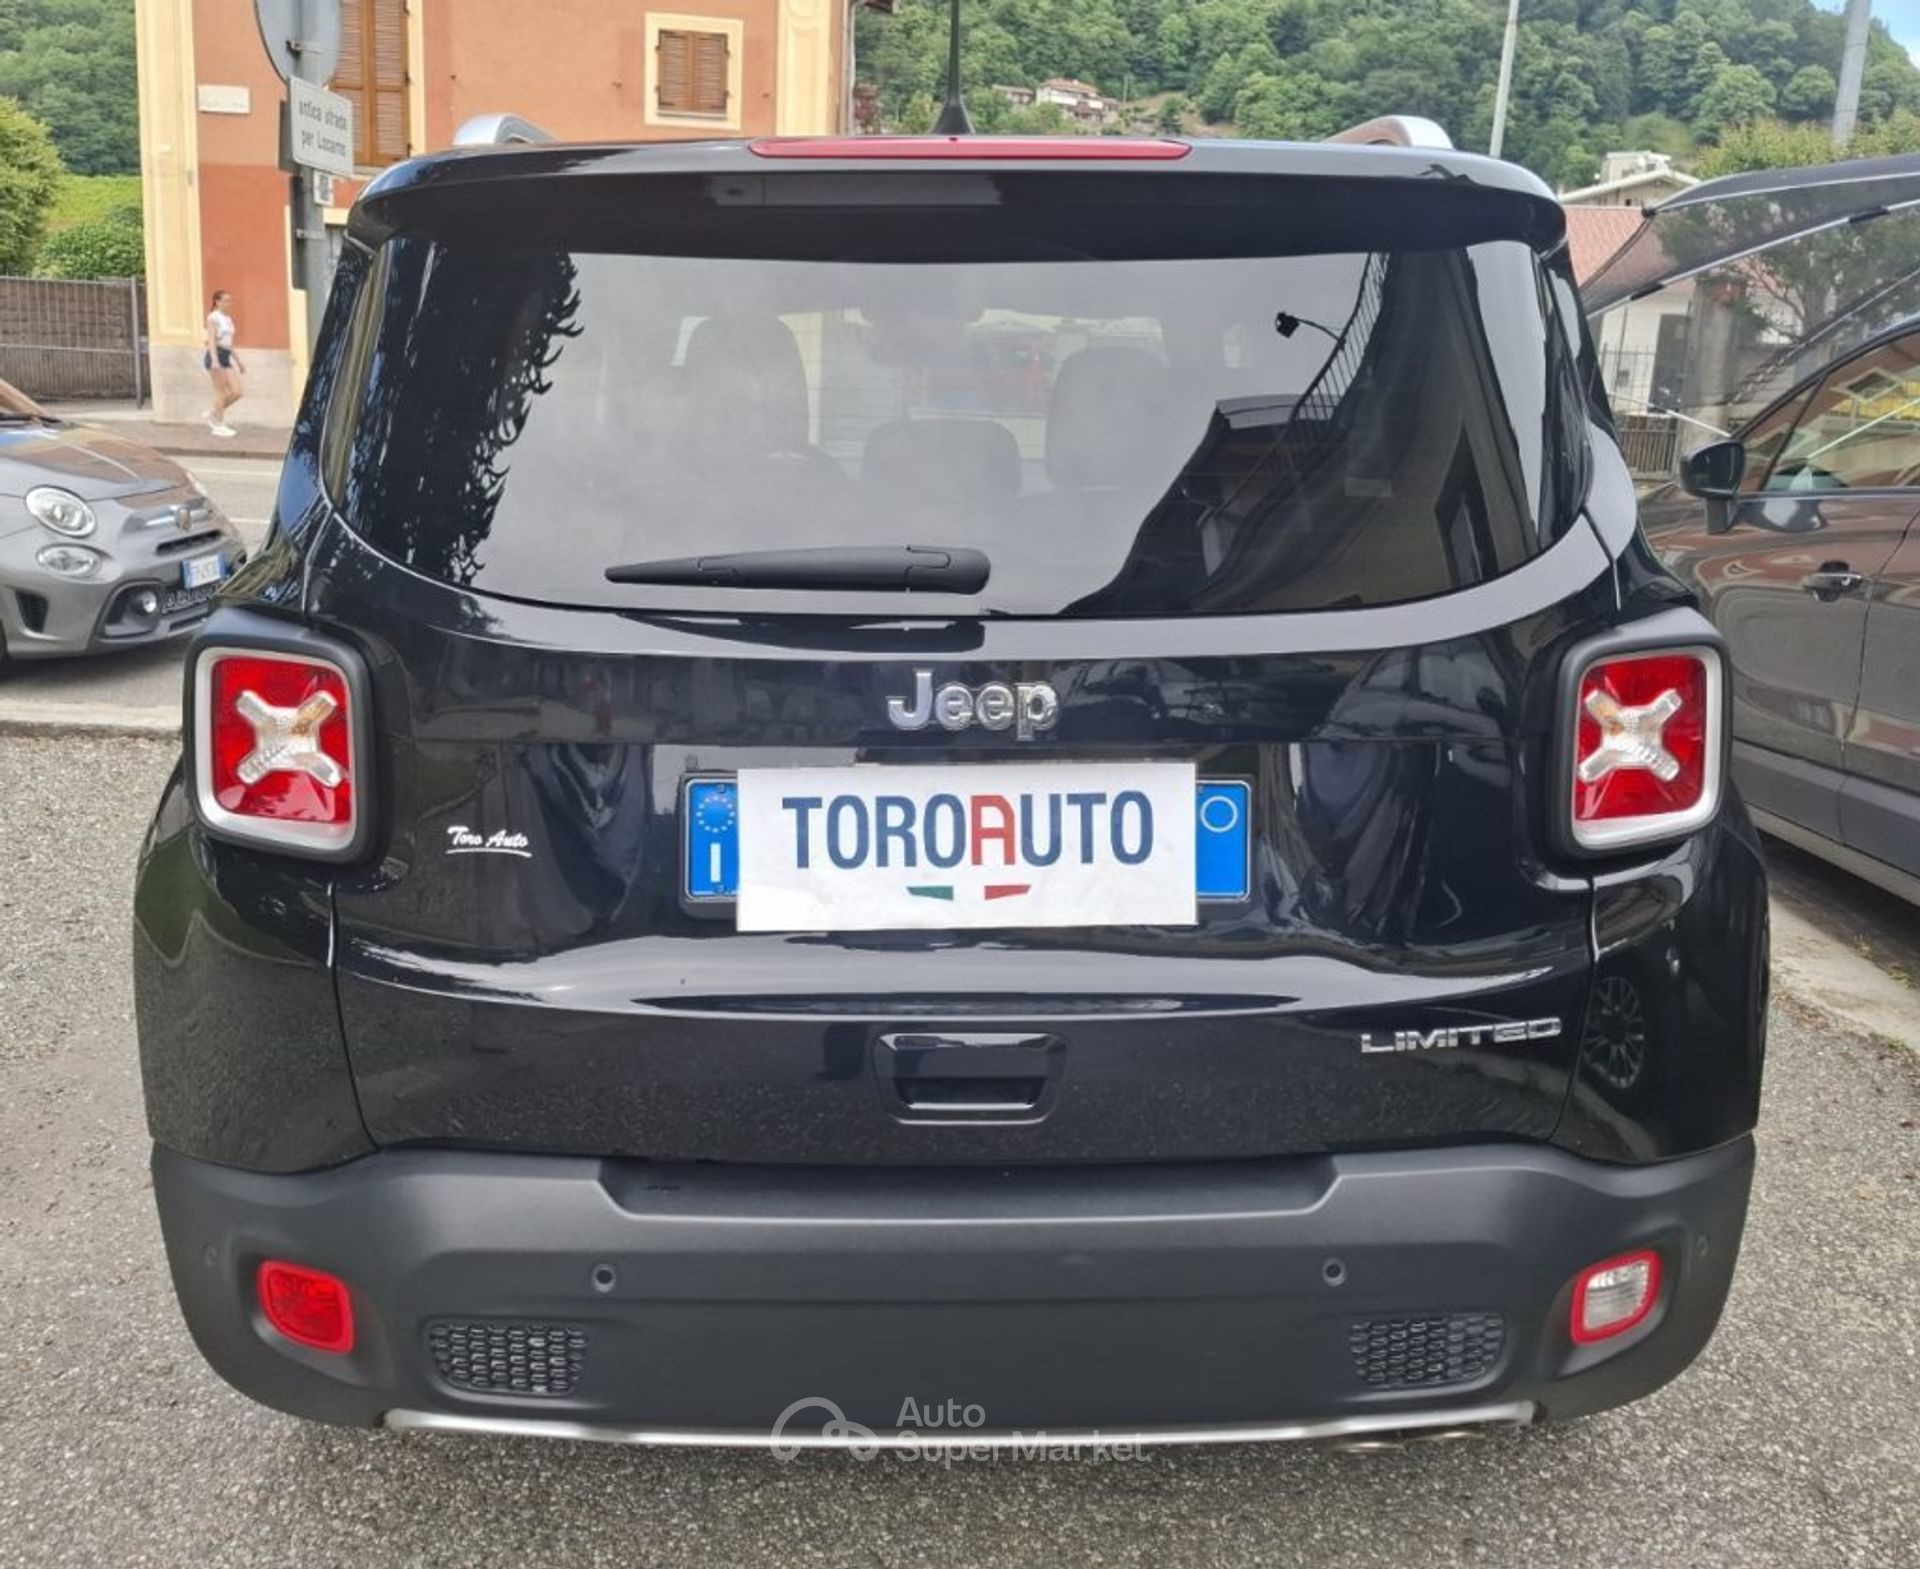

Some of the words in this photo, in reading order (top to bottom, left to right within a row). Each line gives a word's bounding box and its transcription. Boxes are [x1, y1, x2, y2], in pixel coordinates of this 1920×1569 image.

[301, 131, 314, 149] per
[886, 668, 1059, 741] Jeep
[447, 825, 483, 846] Toro
[485, 829, 529, 848] Auto
[781, 790, 1154, 869] TOROAUTO
[1360, 1017, 1561, 1053] LIMITED
